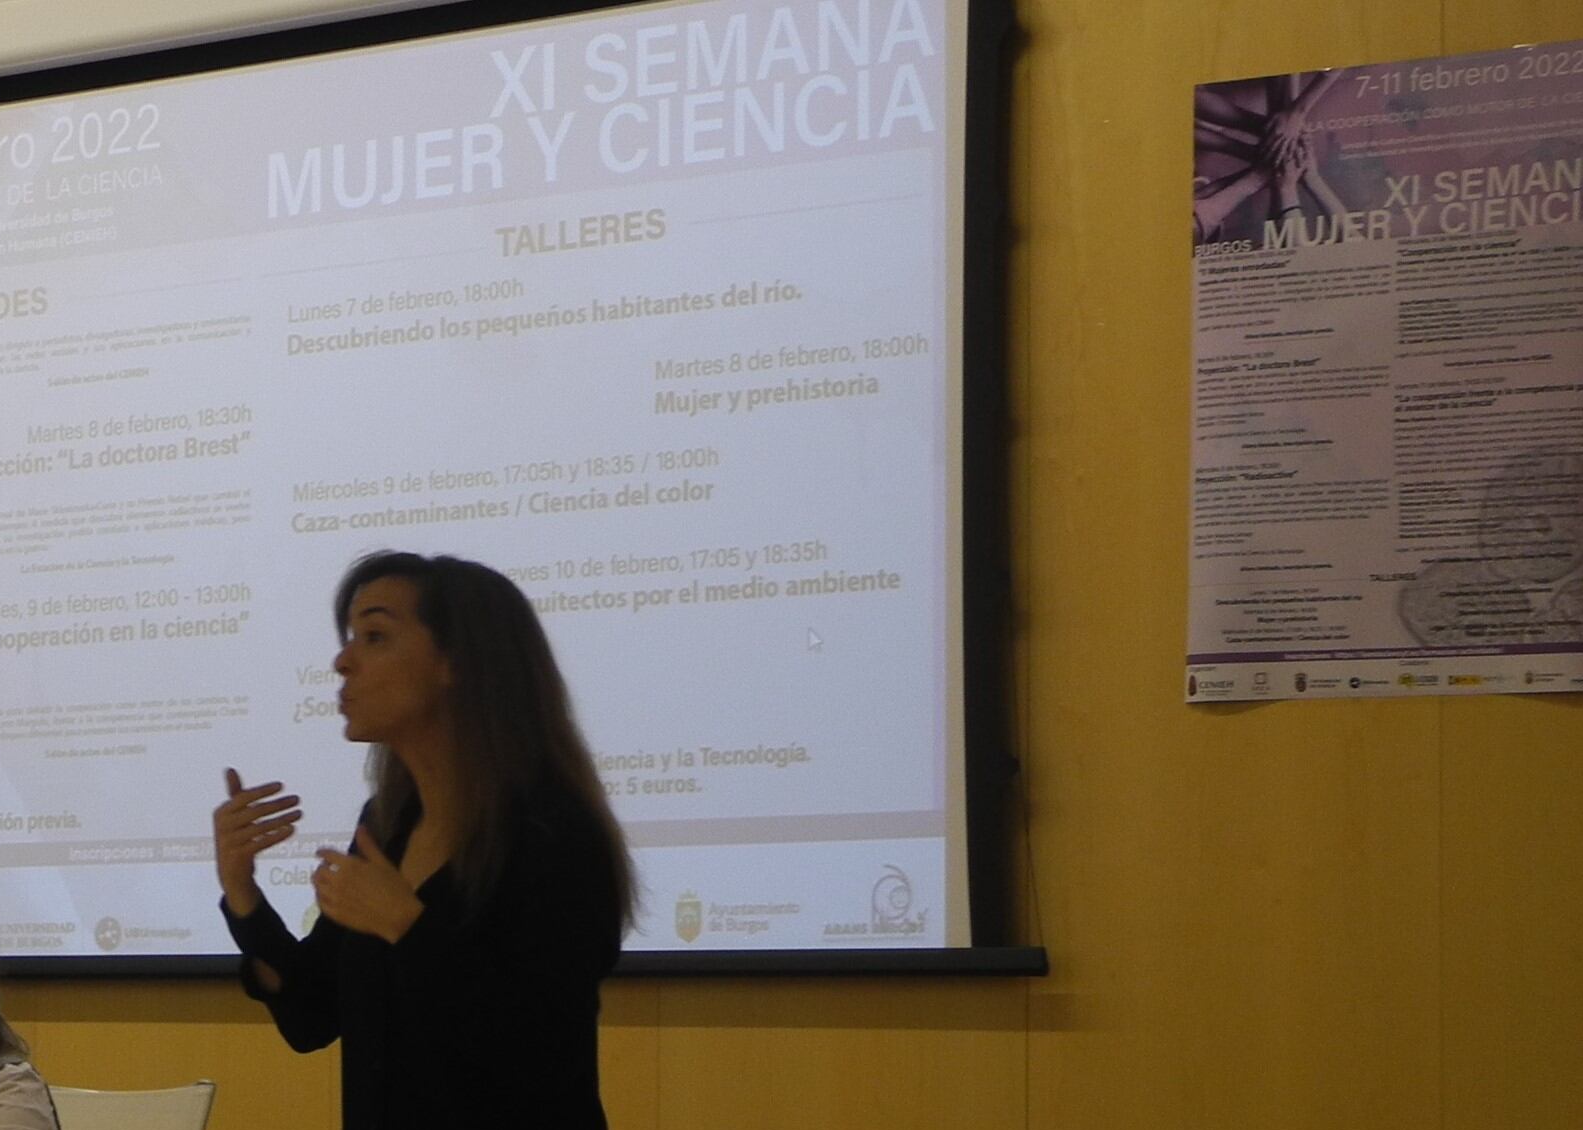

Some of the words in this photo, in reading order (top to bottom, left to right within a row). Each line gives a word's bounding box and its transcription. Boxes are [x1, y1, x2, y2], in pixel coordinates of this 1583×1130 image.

[489, 41, 556, 119] XI
[583, 0, 936, 104] SEMANA
[1354, 70, 1400, 99] 7-11
[1410, 57, 1509, 92] febrero
[1519, 49, 1582, 80] 2022
[50, 102, 161, 164] 2022
[267, 122, 504, 219] MUJER
[527, 110, 576, 183] Y
[598, 63, 936, 174] CIENCIA
[5, 180, 35, 207] DE
[45, 177, 71, 201] LA
[77, 164, 164, 196] CIENCIA
[1383, 173, 1419, 207] XI
[1432, 157, 1581, 203] SEMAN
[495, 208, 666, 258] TALLERES
[1262, 208, 1390, 251] MUJER
[1402, 204, 1428, 237] Y
[1438, 189, 1579, 234] CIENCI
[1194, 239, 1251, 257] BURGOS
[287, 302, 342, 324] Lunes
[346, 297, 357, 316] 7
[360, 294, 385, 316] de
[388, 289, 459, 311] febrero,
[463, 277, 524, 303] 18:00h
[287, 320, 435, 357] Descubriendo
[440, 316, 472, 339] los
[476, 304, 587, 340] pequeños
[591, 292, 716, 323] habitantes
[720, 281, 758, 308] del
[763, 279, 804, 304] río.
[654, 358, 725, 381] Martes
[728, 352, 742, 373] 8
[747, 352, 774, 372] de
[778, 345, 856, 368] febrero,
[863, 334, 928, 360] 18:00h
[654, 390, 723, 418] Mujer
[727, 390, 742, 414] y
[746, 377, 880, 412] prehistoria
[27, 424, 85, 444] Martes
[88, 419, 99, 439] 8
[102, 418, 124, 437] de
[127, 413, 189, 434] febrero,
[197, 403, 253, 427] 18:30h
[57, 448, 94, 471] "La
[97, 443, 179, 468] doctora
[183, 430, 252, 459] Brest"
[292, 477, 380, 502] Miércoles
[383, 475, 395, 495] 9
[399, 472, 423, 493] de
[428, 470, 499, 491] febrero,
[503, 460, 564, 483] 17:05h
[568, 464, 580, 484] y
[584, 453, 635, 477] 18:35
[656, 446, 720, 471] 18:00h
[290, 500, 510, 534] Caza-contaminantes
[528, 487, 610, 515] Ciencia
[614, 483, 650, 508] del
[655, 478, 715, 504] color
[505, 565, 550, 586] eves
[554, 559, 575, 580] 10
[579, 557, 605, 578] de
[610, 554, 680, 576] febrero,
[689, 546, 741, 568] 17:05
[745, 550, 758, 571] y
[763, 539, 828, 564] 18:35h
[632, 588, 674, 614] por
[678, 580, 699, 604] el
[704, 575, 779, 602] medio
[785, 569, 902, 597] ambiente
[108, 624, 136, 643] en
[139, 618, 159, 641] la
[162, 610, 250, 640] ciencia"
[597, 754, 655, 772] iencia
[661, 754, 671, 772] y
[677, 749, 695, 768] la
[700, 744, 812, 769] Tecnología.
[628, 777, 638, 796] 5
[642, 777, 702, 795] euros.
[27, 809, 82, 833] previa.
